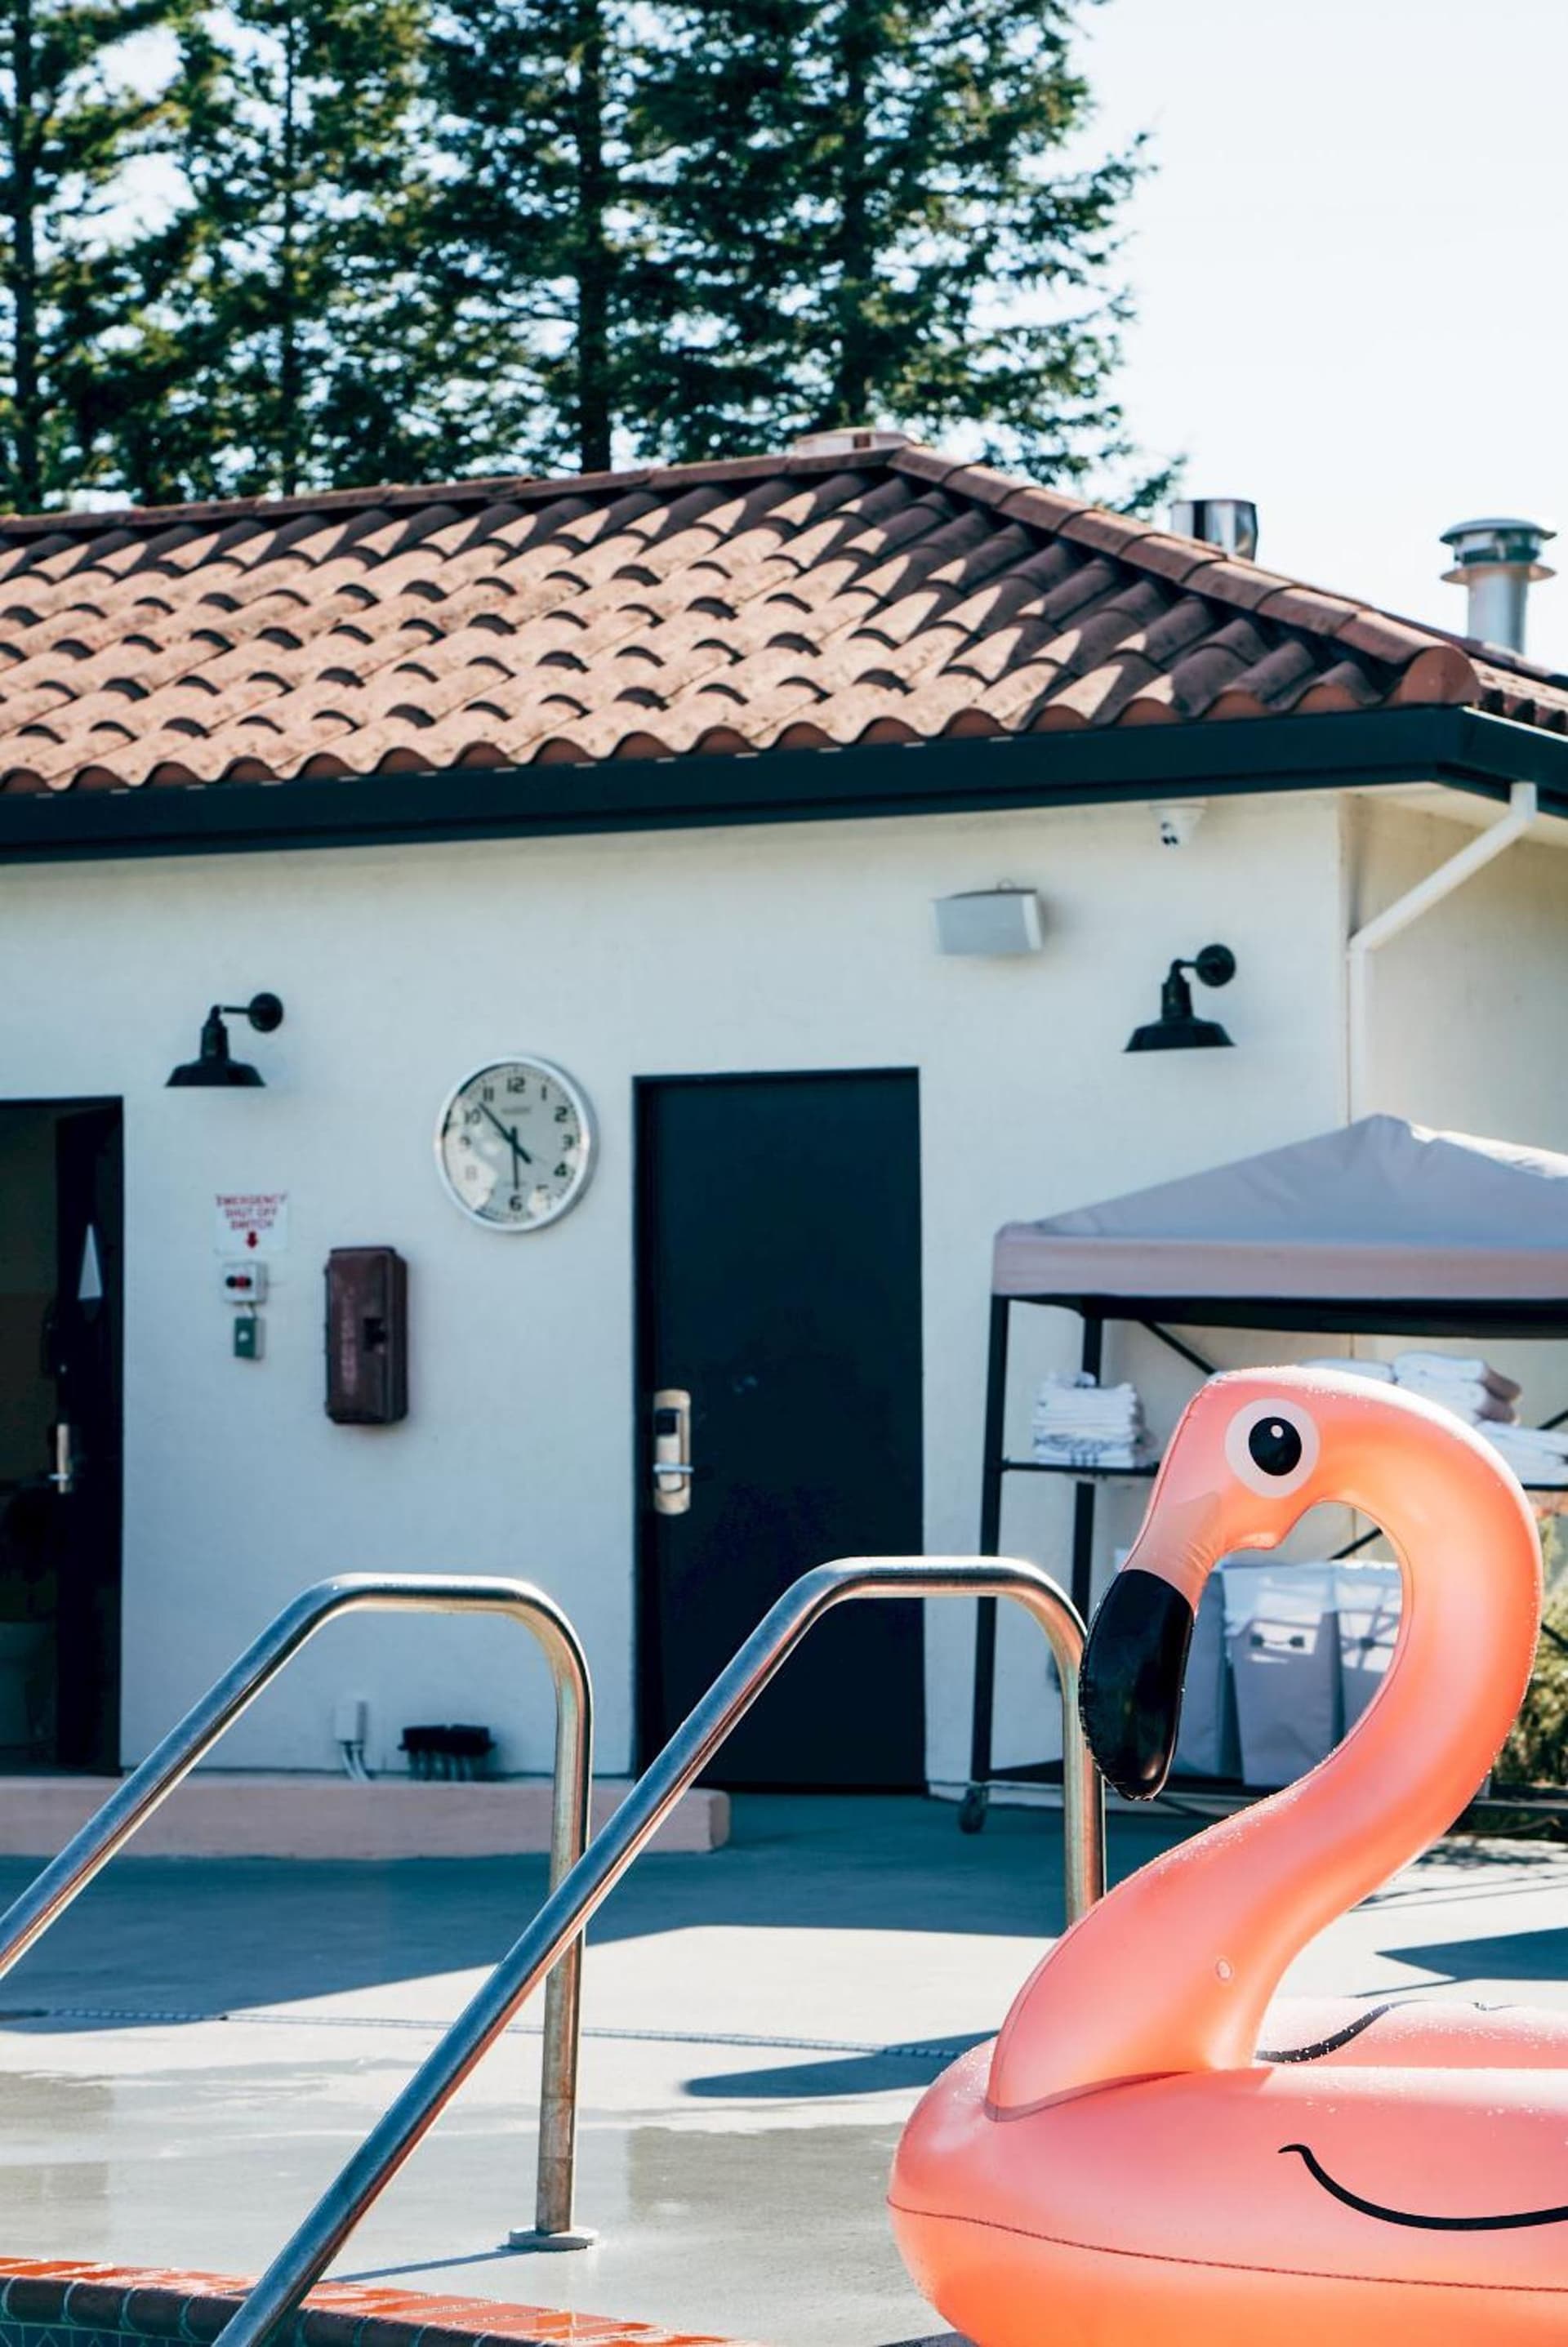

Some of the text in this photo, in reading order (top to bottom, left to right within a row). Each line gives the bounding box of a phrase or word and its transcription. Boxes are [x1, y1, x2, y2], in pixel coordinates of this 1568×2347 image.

[507, 1077, 525, 1093] 12
[483, 1087, 494, 1102] 11
[541, 1086, 547, 1101] 1
[465, 1108, 481, 1125] 10
[555, 1107, 568, 1123] 2
[563, 1133, 573, 1151] 3
[554, 1162, 567, 1177] 4
[509, 1196, 522, 1212] 6
